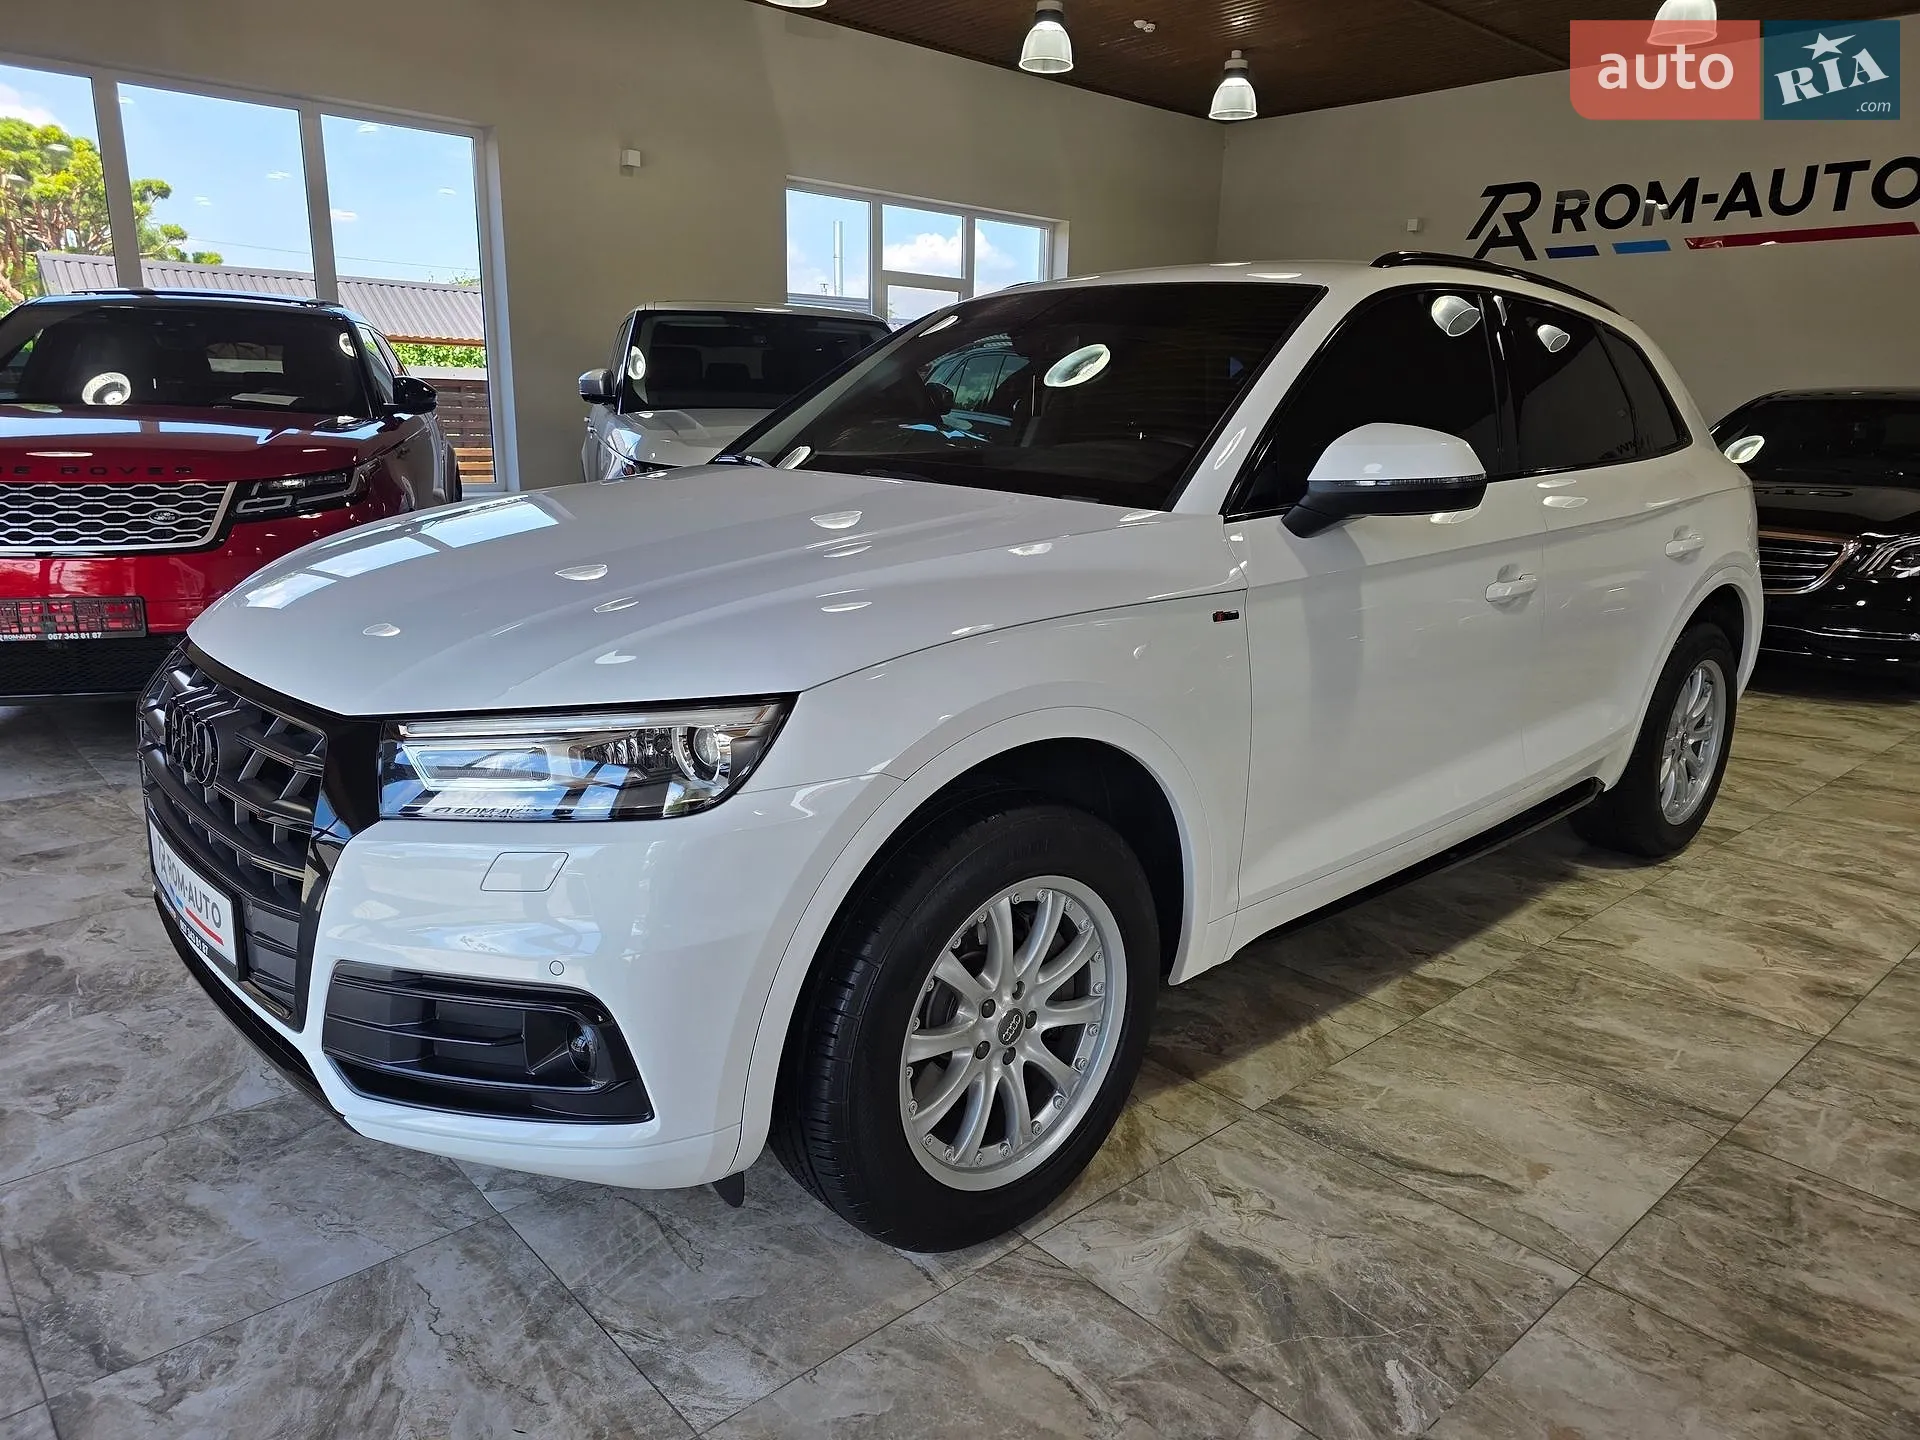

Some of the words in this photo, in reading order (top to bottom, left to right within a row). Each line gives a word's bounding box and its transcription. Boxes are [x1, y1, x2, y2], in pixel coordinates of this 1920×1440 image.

[1551, 156, 1920, 235] ROM-AUTO
[60, 466, 193, 476] ROVER
[166, 853, 222, 929] ROM-AUTO
